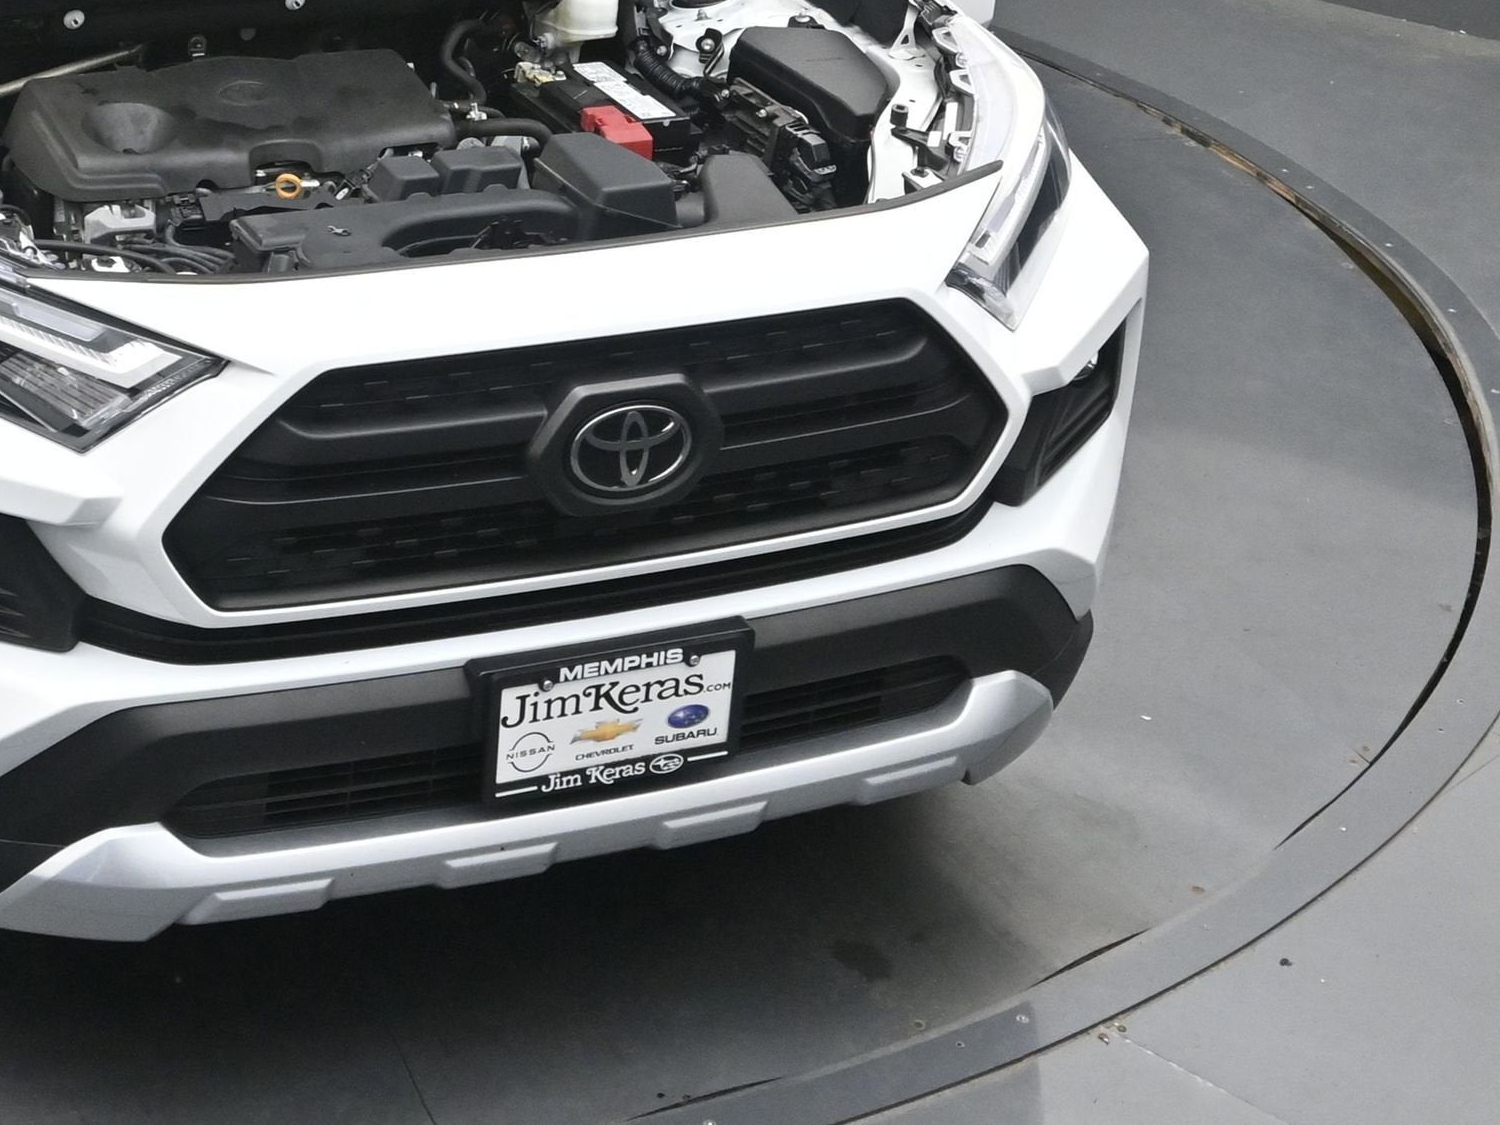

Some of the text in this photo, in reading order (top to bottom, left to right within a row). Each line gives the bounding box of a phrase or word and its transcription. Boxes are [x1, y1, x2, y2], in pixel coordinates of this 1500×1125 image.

[559, 648, 683, 682] MEMPHIS
[654, 727, 718, 745] SUBARU
[506, 744, 555, 760] NISSAN
[575, 744, 634, 761] CHEVROLET
[541, 761, 646, 793] Jim Keras
